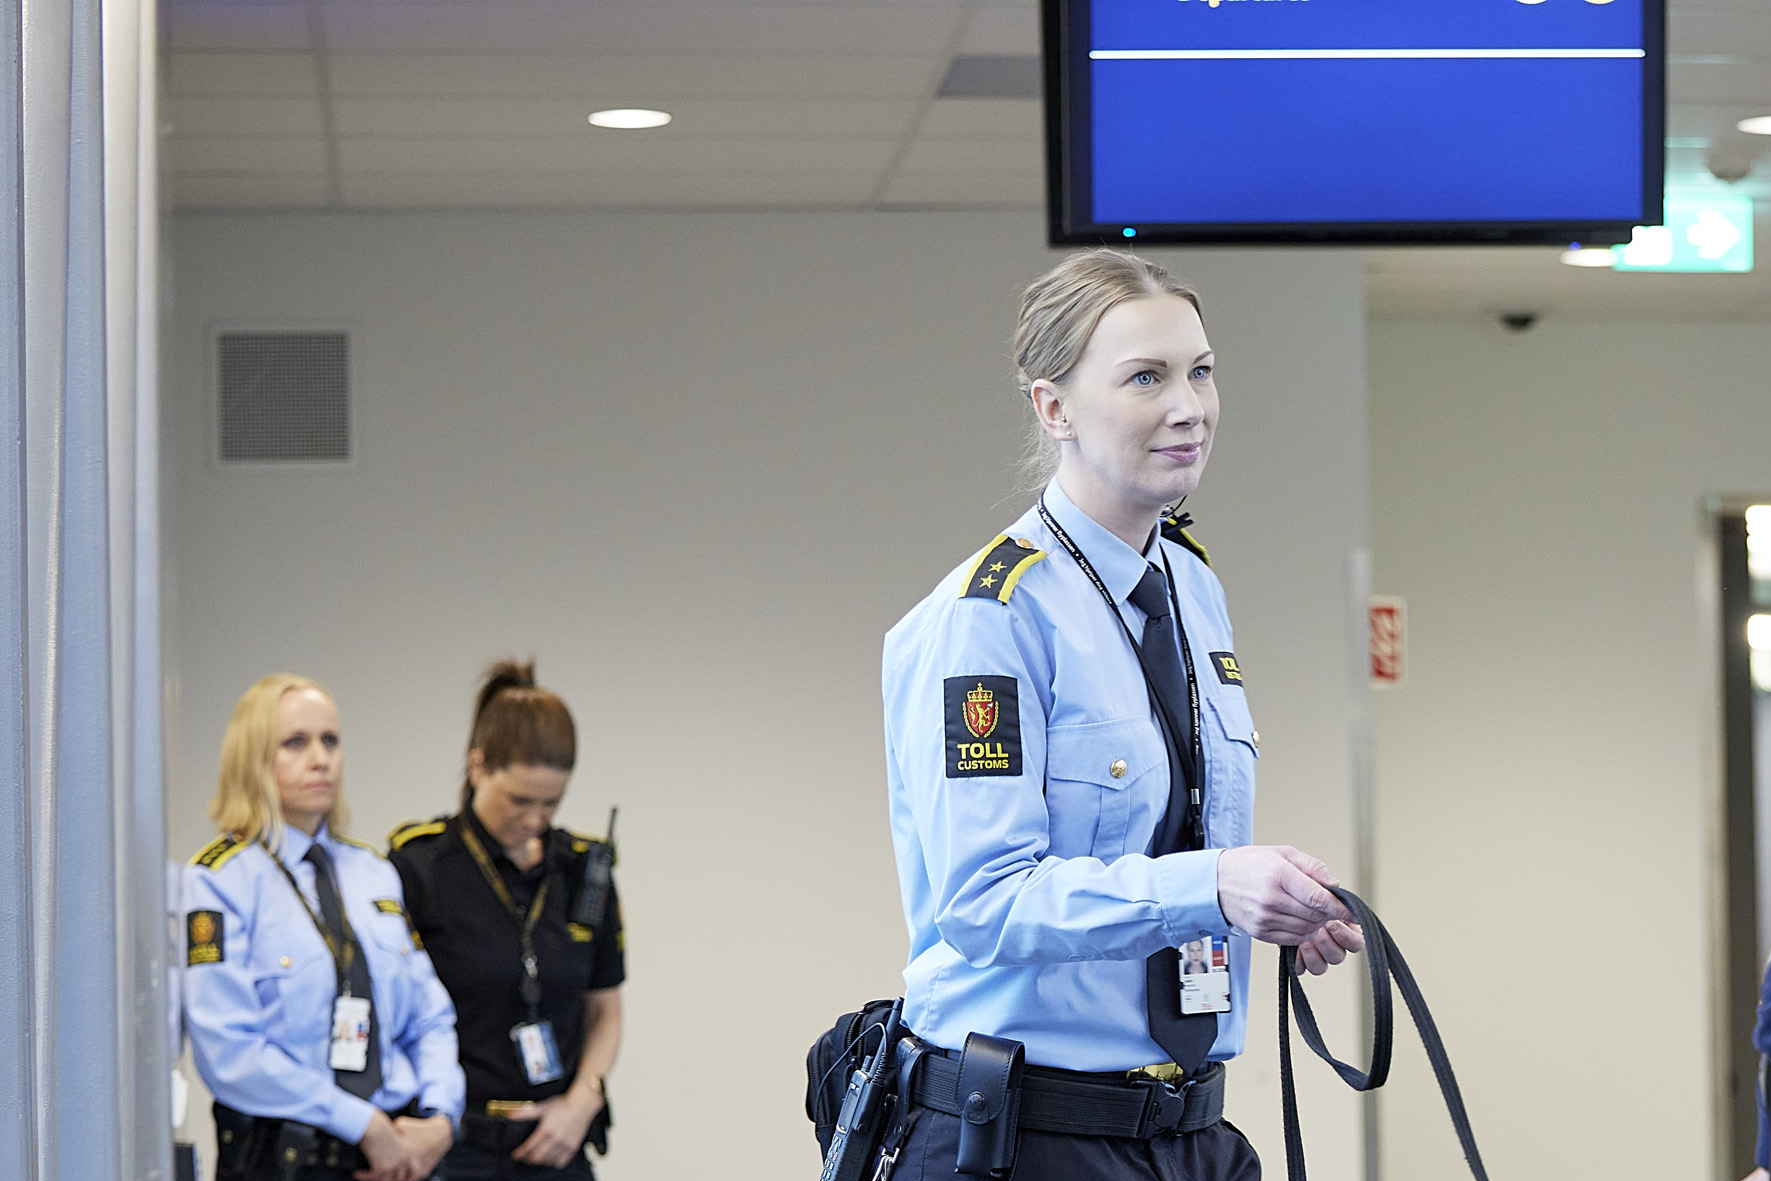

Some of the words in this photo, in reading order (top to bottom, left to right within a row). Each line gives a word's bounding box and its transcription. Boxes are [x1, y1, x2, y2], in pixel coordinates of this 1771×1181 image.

[1056, 530, 1076, 553] flyplassen
[1190, 682, 1199, 708] flyplassen
[957, 742, 1009, 760] TOLL
[957, 759, 1009, 771] CUSTOMS
